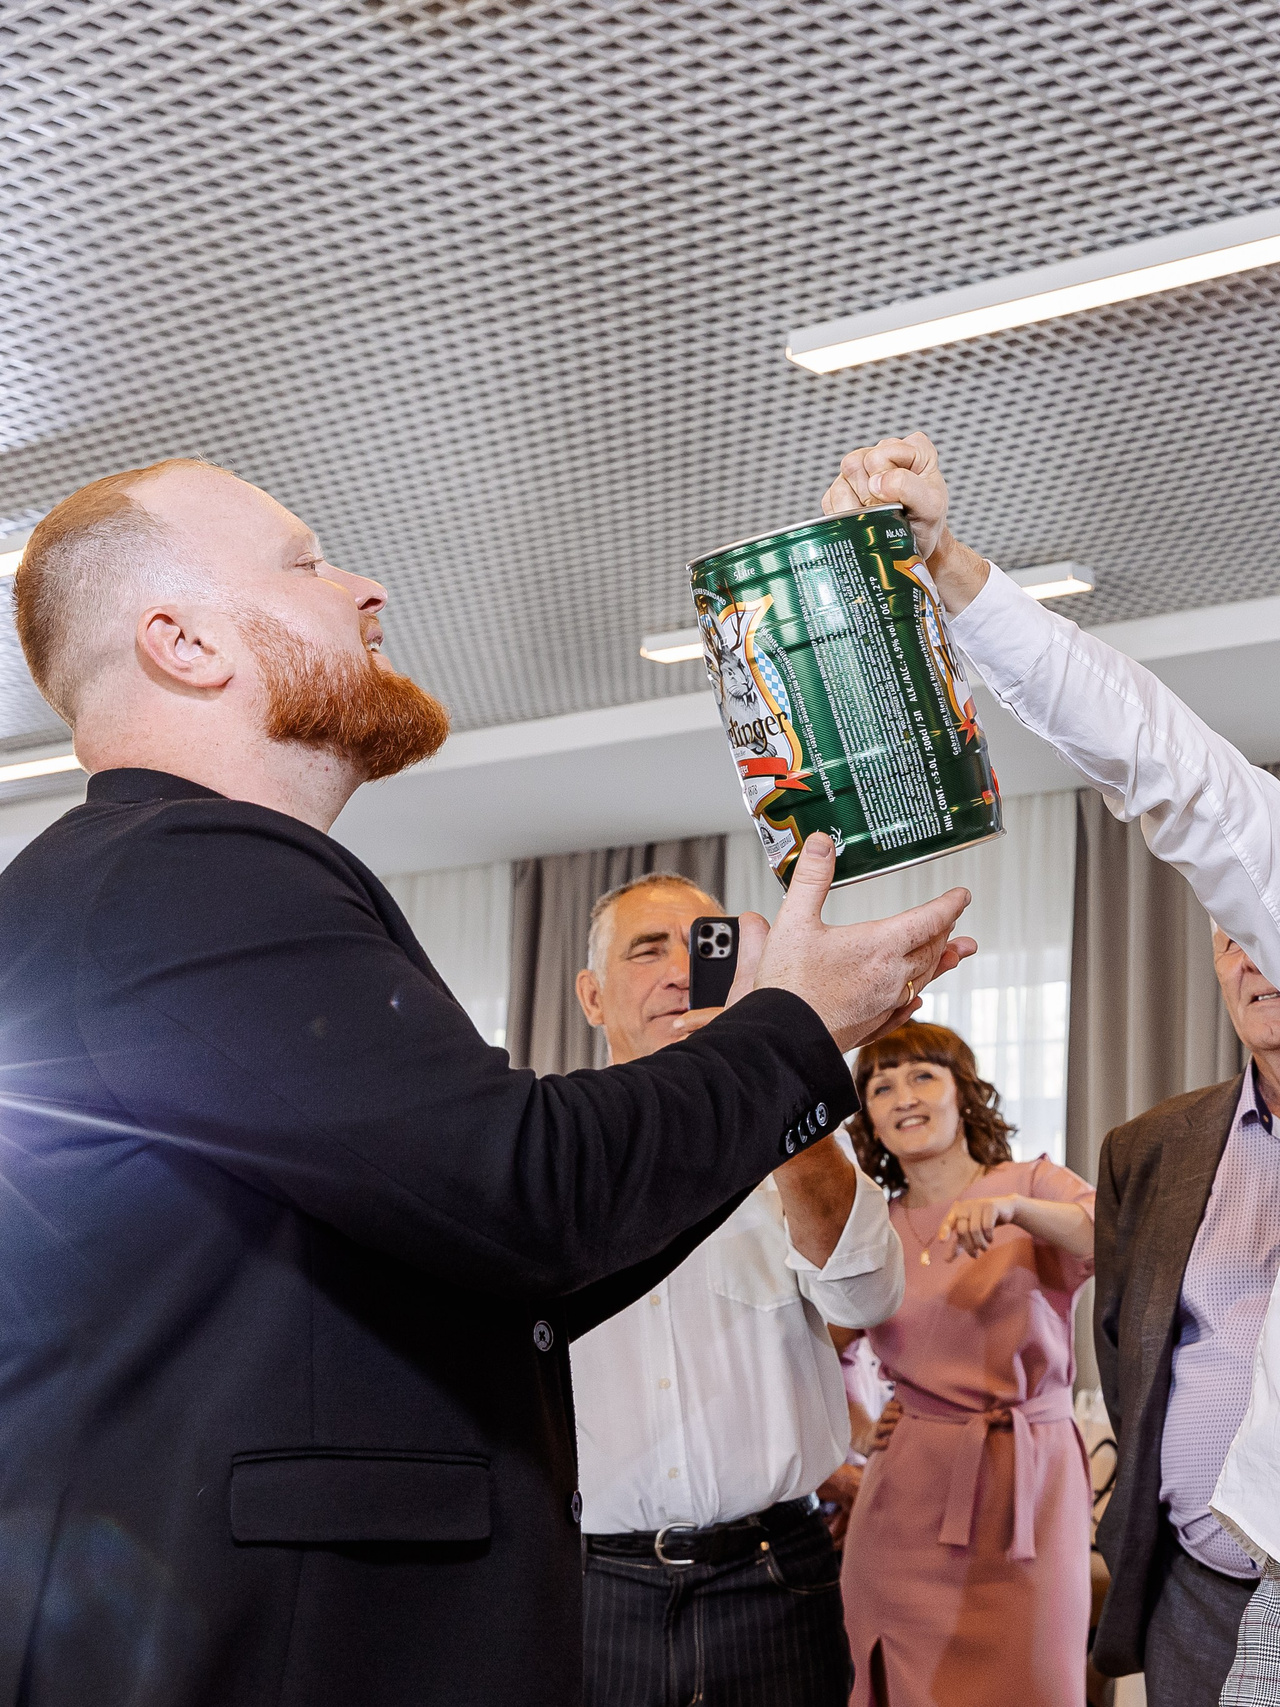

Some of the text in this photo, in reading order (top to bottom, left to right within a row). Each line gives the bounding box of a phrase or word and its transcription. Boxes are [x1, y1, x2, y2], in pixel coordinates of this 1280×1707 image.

[868, 574, 885, 602] 11.2°P
[911, 587, 920, 602] 1878
[912, 603, 921, 618] Seit
[885, 621, 897, 637] vol.
[890, 637, 905, 660] 4,9%
[914, 624, 936, 682] Handwerkskunst
[776, 645, 797, 679] Güteklasse
[792, 679, 800, 691] mit
[897, 660, 918, 703] ALK./ALC.:
[932, 681, 941, 696] und
[795, 692, 809, 723] erlesenen
[936, 696, 946, 713] Herz
[941, 714, 950, 726] mit
[804, 722, 819, 748] Zutaten
[918, 728, 933, 751] 500cl
[946, 727, 959, 756] Gebraut
[814, 752, 825, 767] Echt
[818, 767, 828, 780] und
[822, 780, 836, 802] Ehrlich
[934, 785, 948, 810] CONT.
[941, 810, 954, 831] INH.
